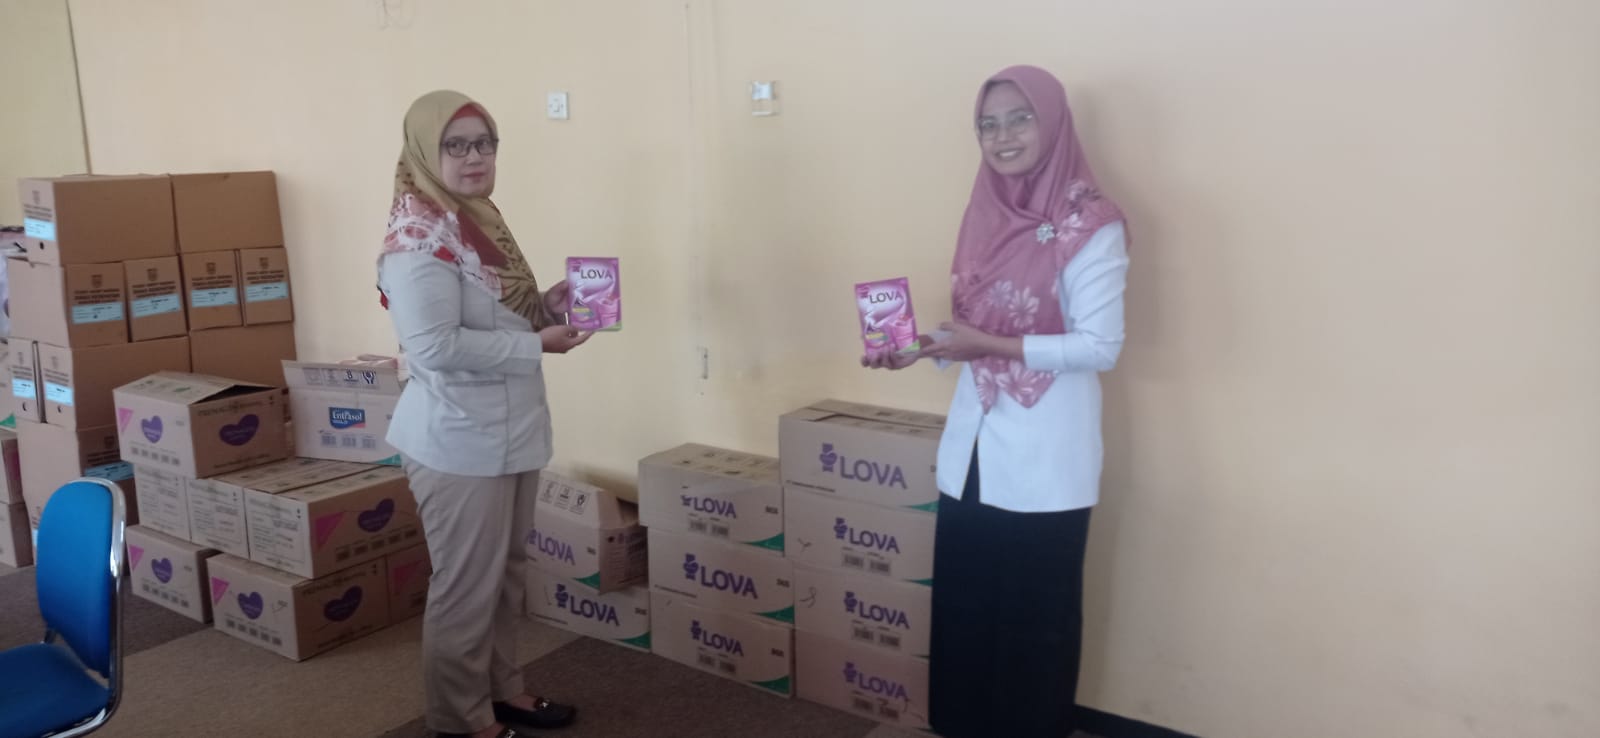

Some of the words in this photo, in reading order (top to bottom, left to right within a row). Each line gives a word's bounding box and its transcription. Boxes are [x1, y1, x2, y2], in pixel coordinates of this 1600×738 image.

[580, 268, 613, 280] LOVA
[869, 290, 904, 304] LOVA
[839, 455, 908, 490] LOVA
[694, 496, 737, 519] LOVA
[537, 532, 576, 566] LOVA
[850, 527, 901, 555] LOVA
[700, 565, 758, 599] LOVA
[570, 595, 620, 627] LOVA
[859, 601, 910, 630] LOVA
[703, 630, 744, 657] LOVA
[858, 672, 910, 700] LOVA
